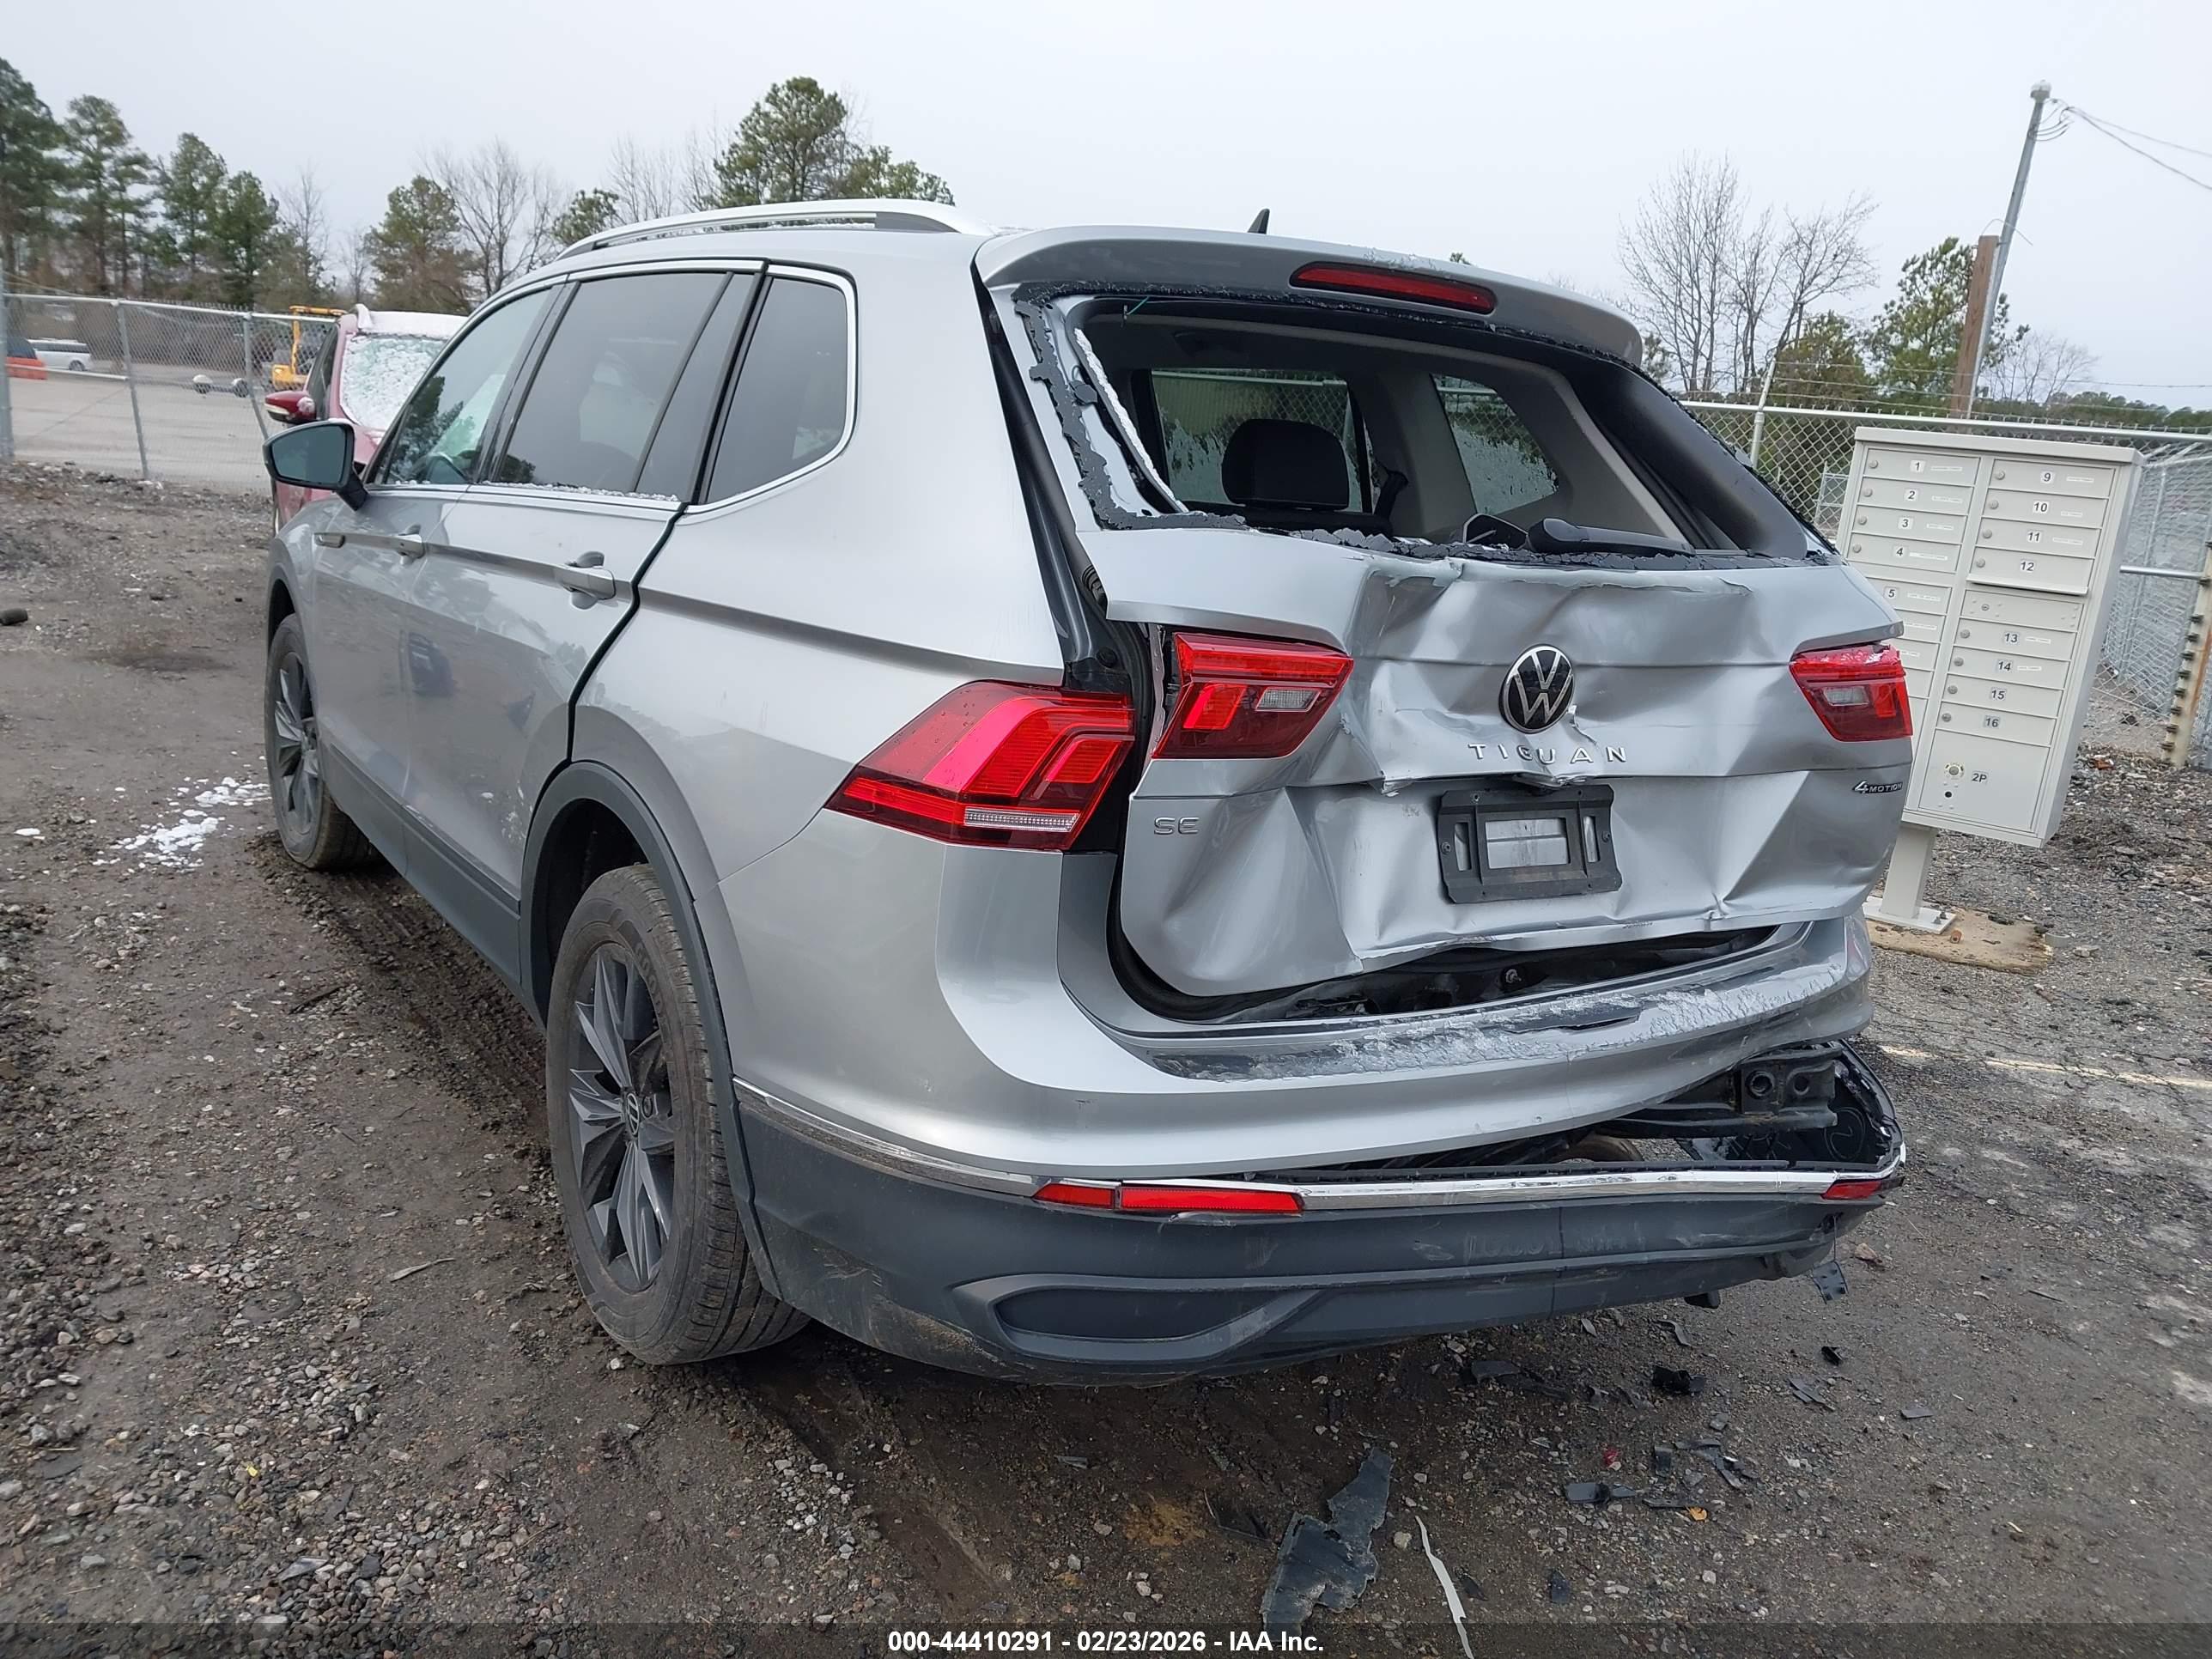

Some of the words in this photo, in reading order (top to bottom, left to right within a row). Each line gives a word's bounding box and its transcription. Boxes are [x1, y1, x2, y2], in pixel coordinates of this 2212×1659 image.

[1914, 462, 1921, 471] 1
[2043, 472, 2051, 483] 9
[1907, 490, 1916, 500] 2
[2034, 502, 2048, 513] 10
[1901, 519, 1909, 528] 3
[2027, 532, 2040, 542] 11
[1896, 547, 1904, 556] 4
[2021, 561, 2034, 572] 12
[1887, 589, 1896, 599] 5
[2005, 633, 2018, 643] 13
[1998, 661, 2012, 672] 14
[1991, 690, 2005, 700] 15
[1985, 717, 1999, 728] 16
[1468, 743, 1628, 764] TIGUAN
[1972, 773, 1988, 783] 2P
[1854, 781, 1903, 794] 4MOTION
[1154, 817, 1200, 835] SE
